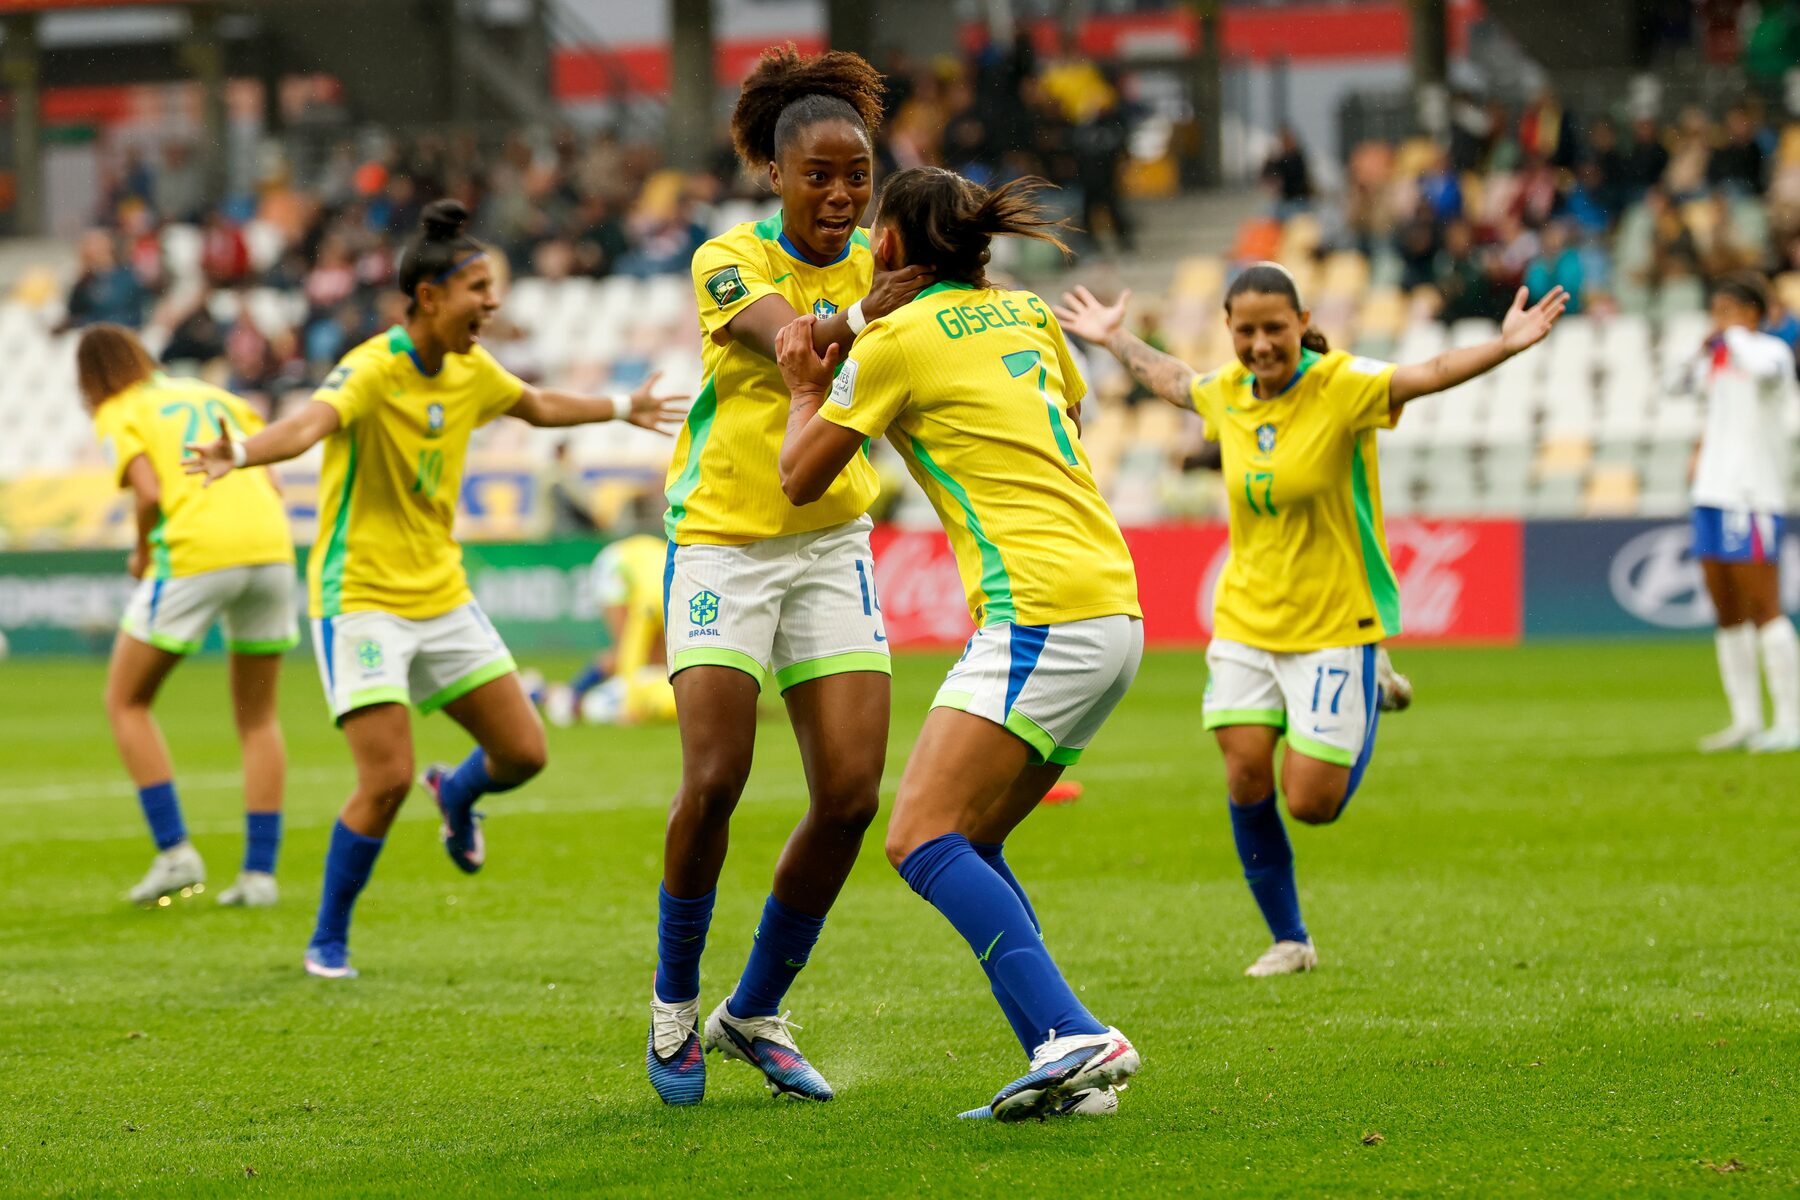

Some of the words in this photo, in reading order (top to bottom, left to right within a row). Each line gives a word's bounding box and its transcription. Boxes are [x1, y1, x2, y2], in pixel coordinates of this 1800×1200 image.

[1026, 297, 1048, 329] S
[1001, 350, 1079, 467] 7
[411, 448, 444, 497] 10
[1244, 472, 1279, 517] 17
[855, 559, 882, 616] 1
[688, 628, 721, 638] BRASIL
[1311, 666, 1350, 714] 17
